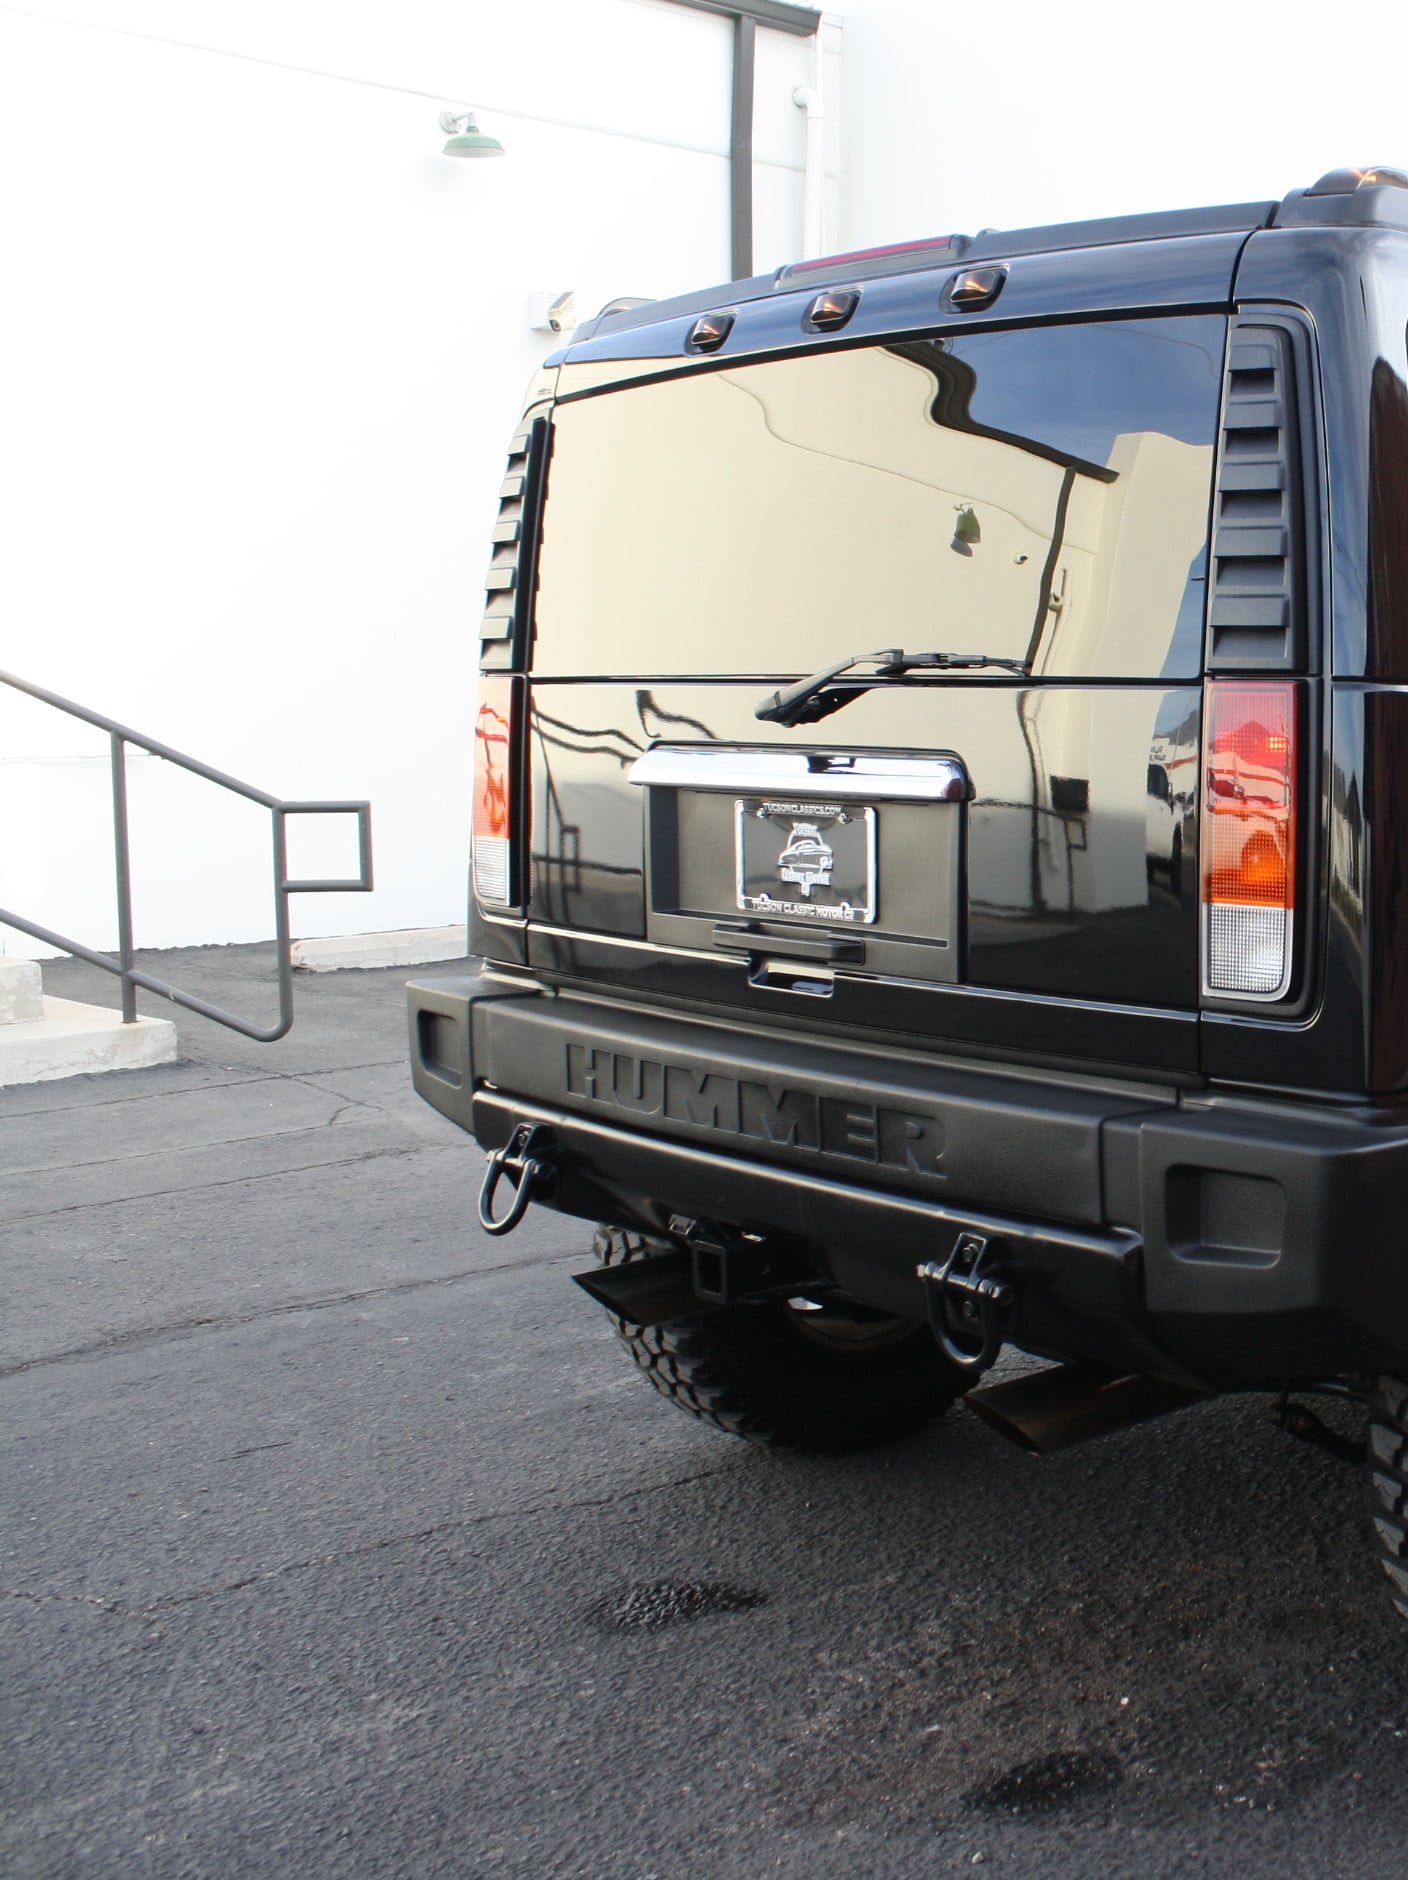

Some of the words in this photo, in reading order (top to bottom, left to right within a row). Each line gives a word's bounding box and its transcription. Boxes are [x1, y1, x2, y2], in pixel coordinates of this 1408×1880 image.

[752, 900, 782, 913] TUCSON
[783, 903, 816, 917] CLASSIC
[816, 907, 844, 919] MOTOR
[566, 1042, 948, 1180] HUMMER
